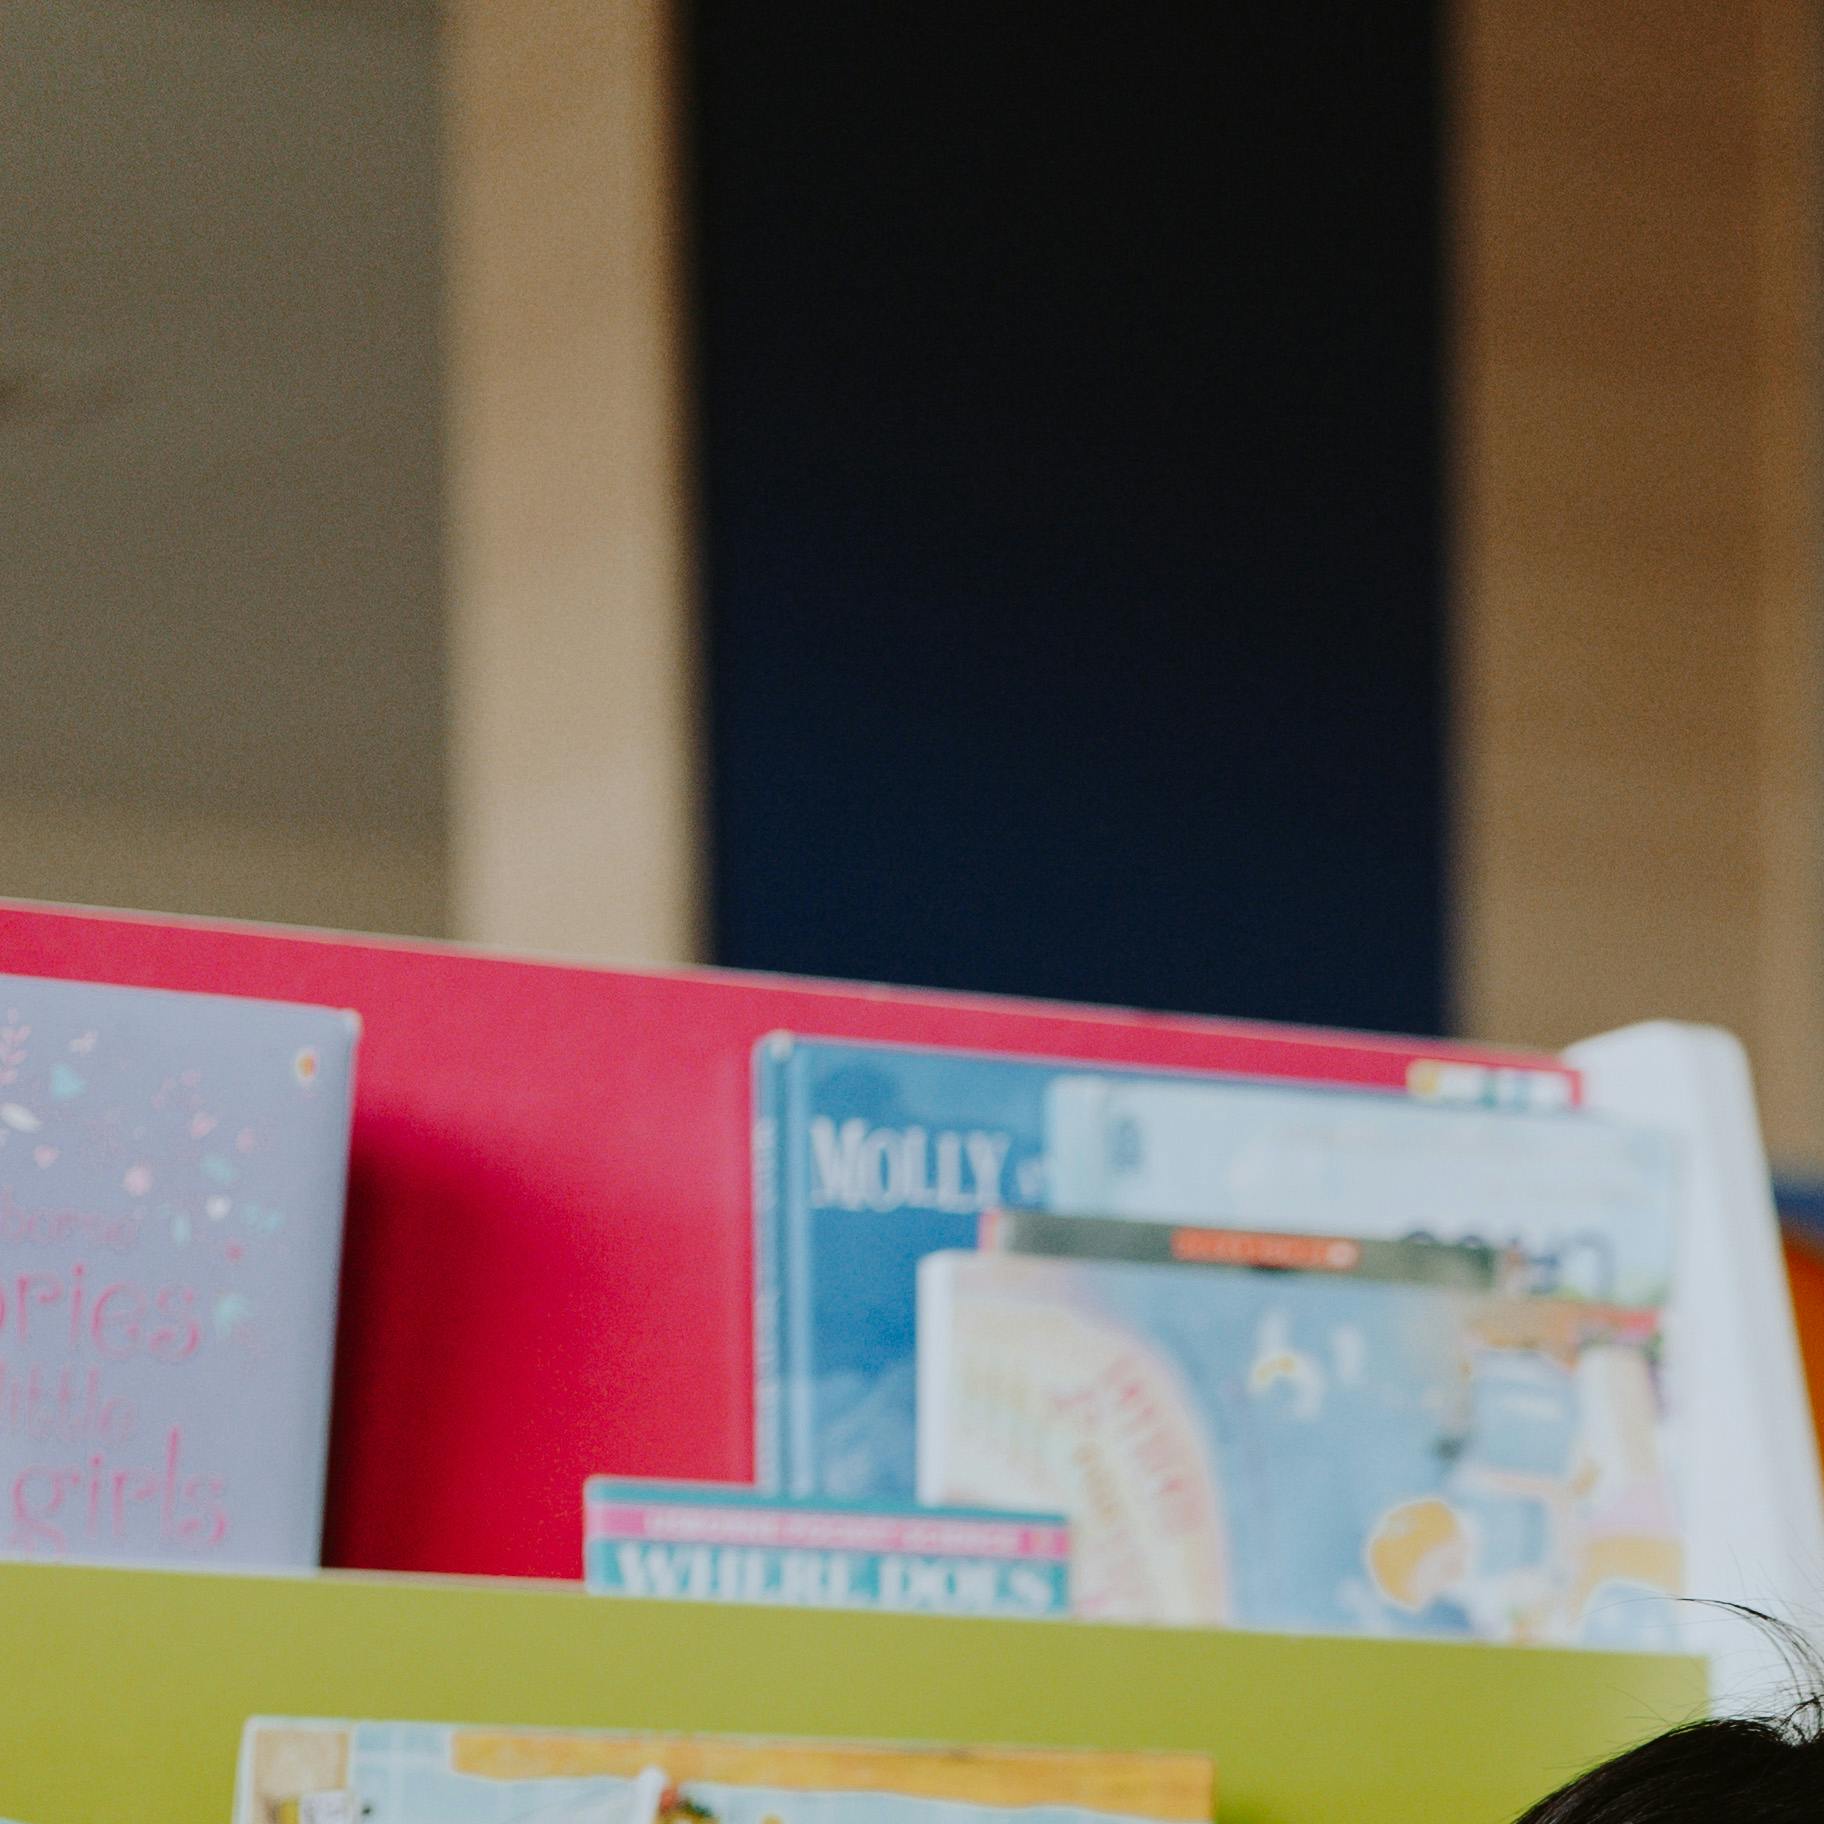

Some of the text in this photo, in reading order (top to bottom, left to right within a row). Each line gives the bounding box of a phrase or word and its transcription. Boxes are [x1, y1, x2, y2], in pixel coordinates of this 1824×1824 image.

[808, 1116, 1013, 1212] MOLLY
[0, 1262, 200, 1358] ries
[10, 1423, 228, 1554] girls
